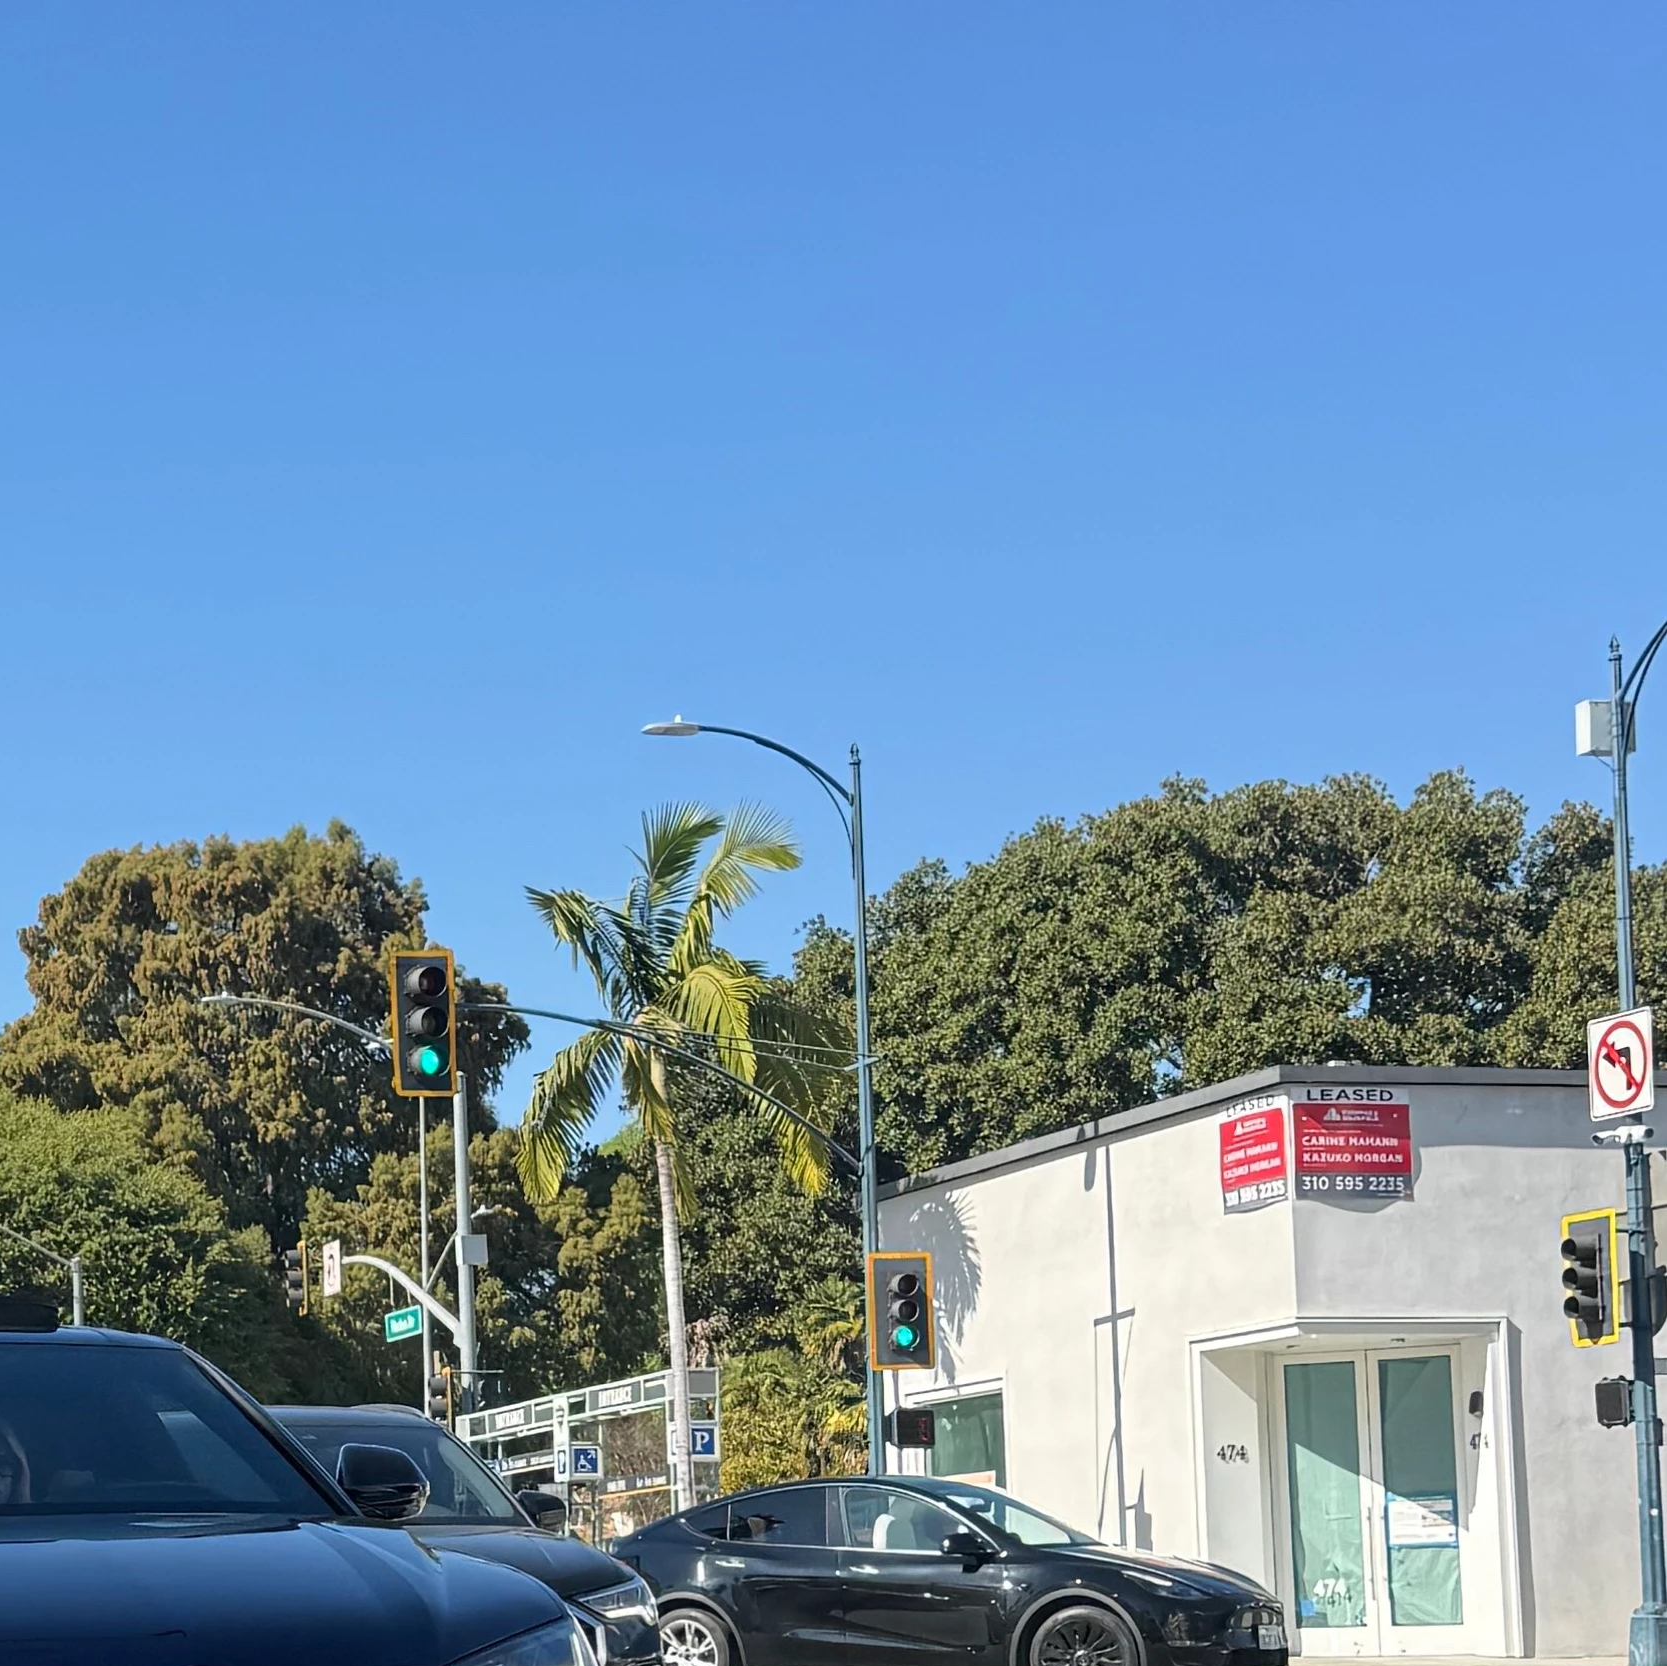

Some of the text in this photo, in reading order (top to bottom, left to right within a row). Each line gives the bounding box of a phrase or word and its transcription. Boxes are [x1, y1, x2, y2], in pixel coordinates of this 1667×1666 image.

[1307, 1089, 1393, 1101] LEASED
[1303, 1153, 1352, 1163] KAZUKO
[1302, 1175, 1404, 1191] 310 595 2235
[693, 1431, 710, 1451] P
[1216, 1444, 1245, 1462] 474
